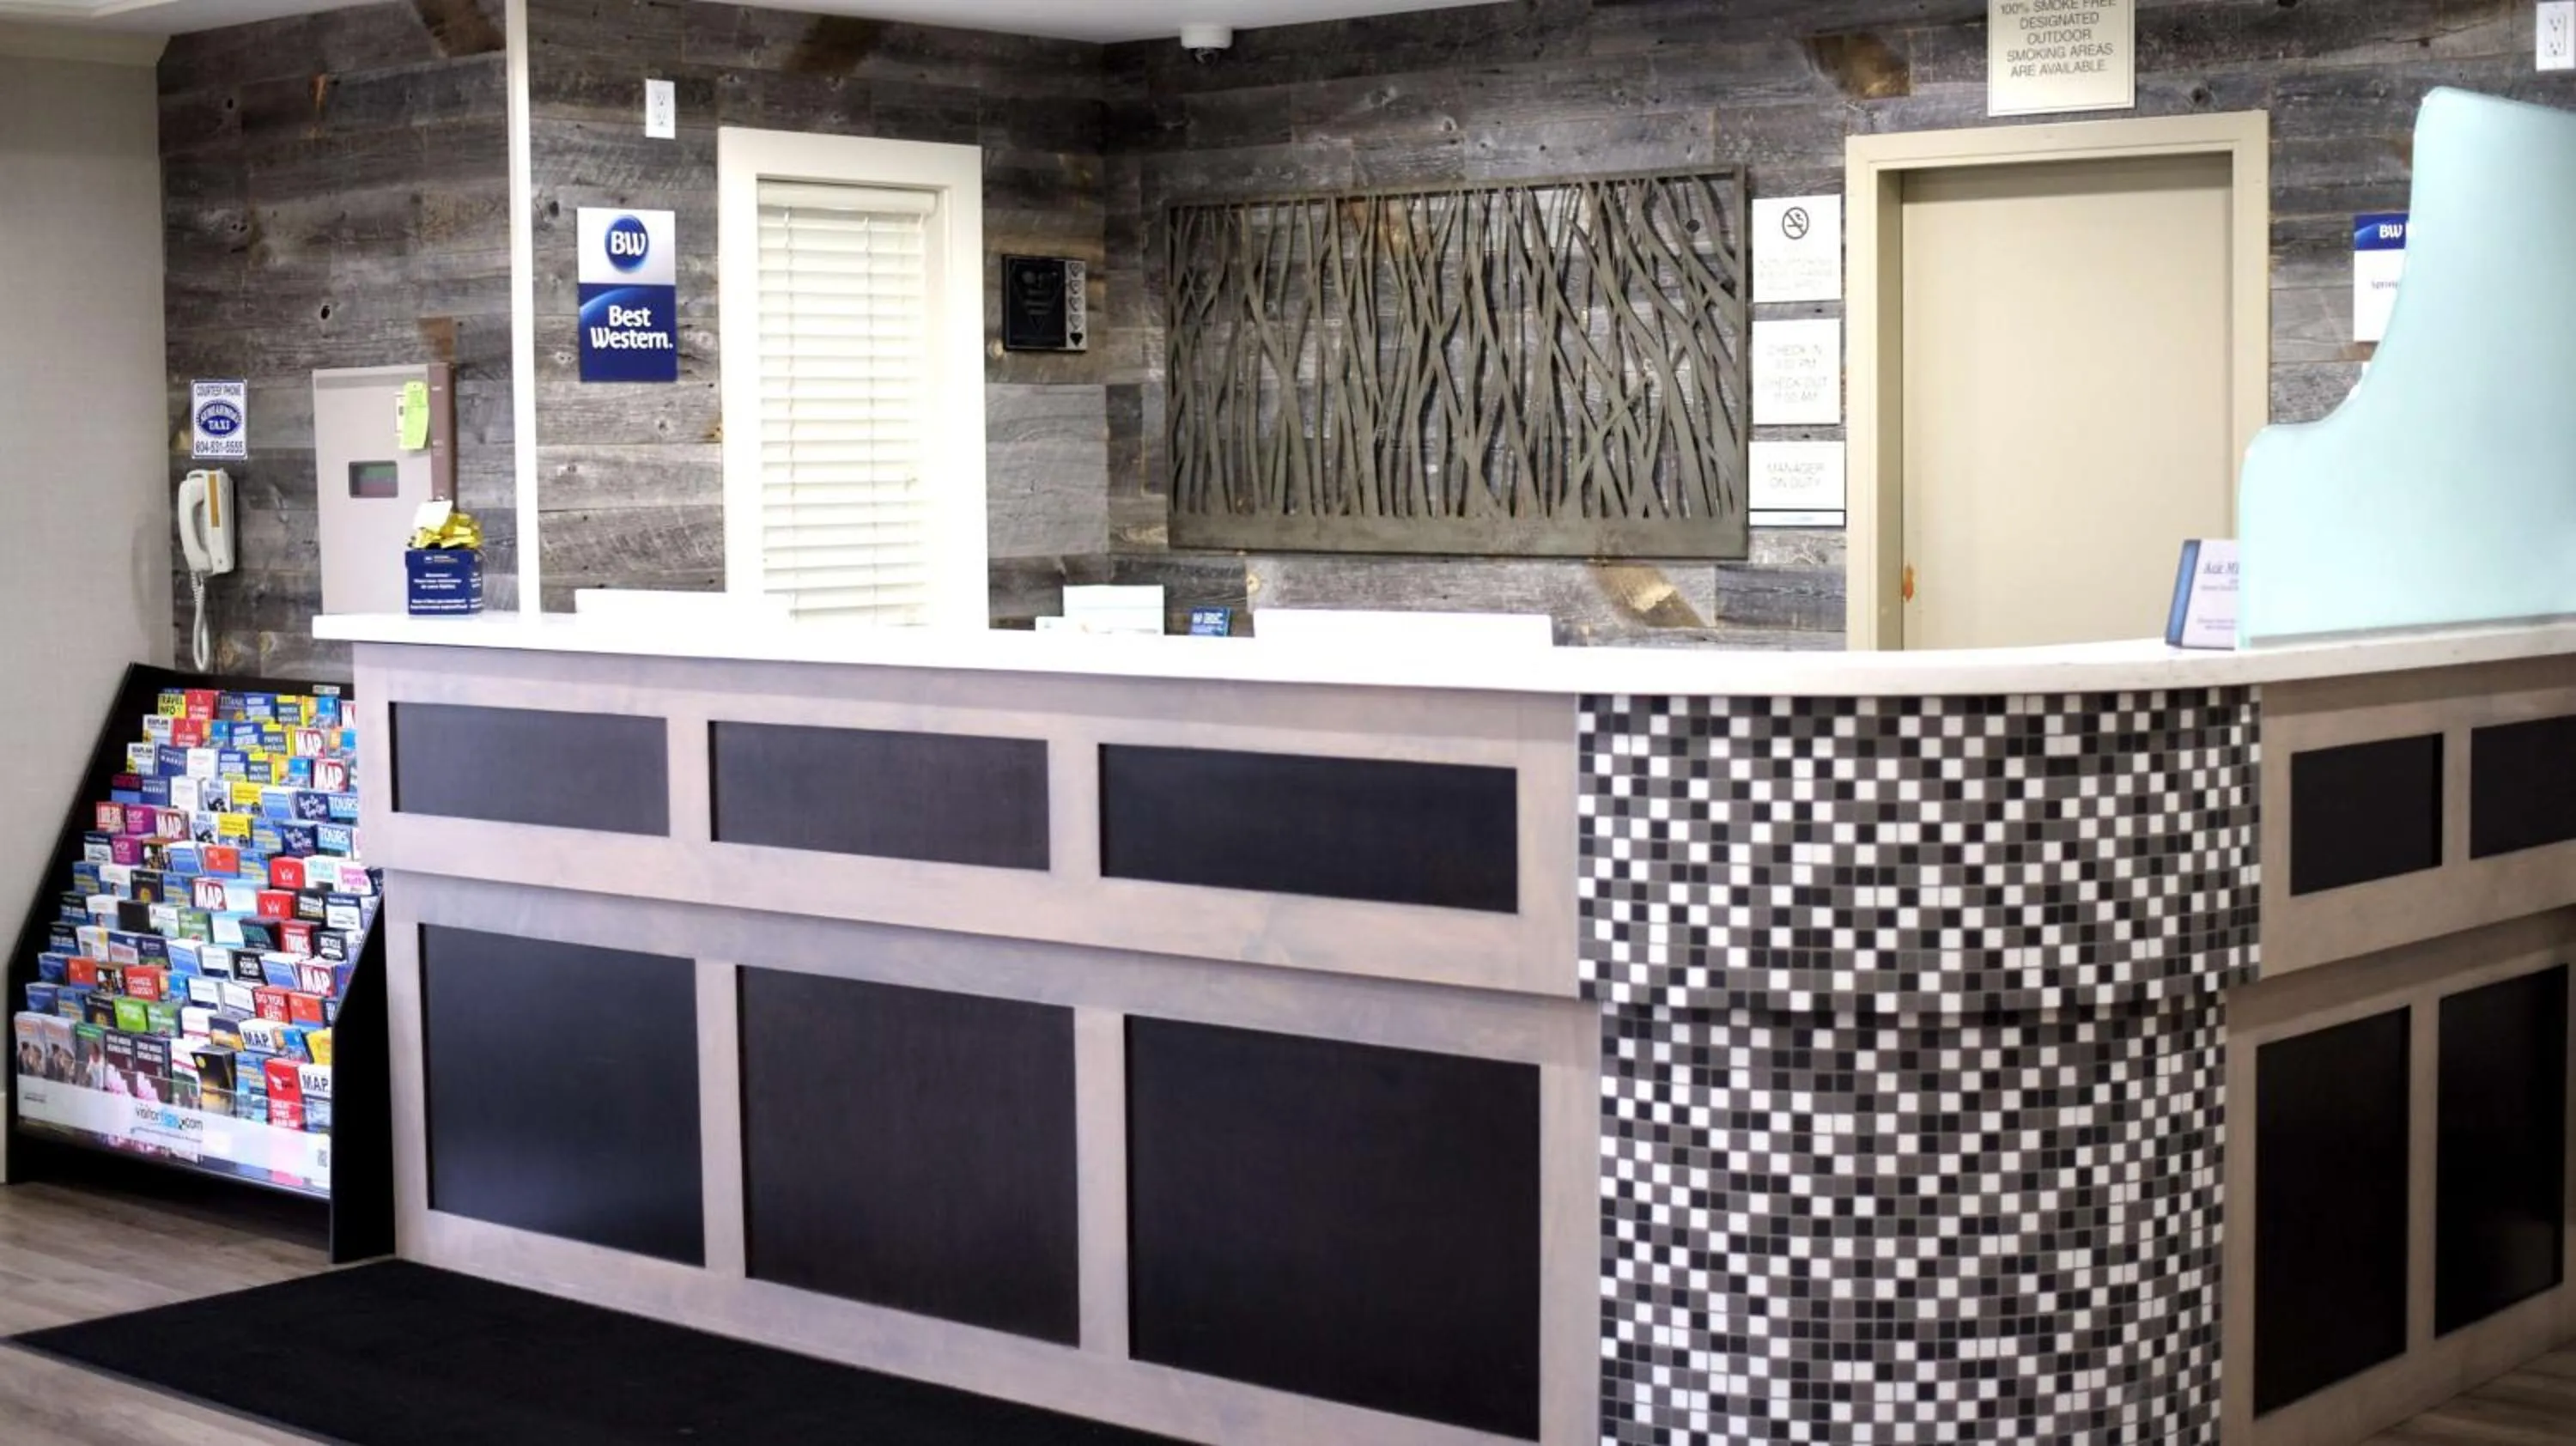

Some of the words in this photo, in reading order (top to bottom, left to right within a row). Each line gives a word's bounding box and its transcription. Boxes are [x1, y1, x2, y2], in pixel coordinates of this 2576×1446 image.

[2033, 0, 2079, 12] SMOKE
[2020, 12, 2099, 29] DESIGNATED
[2026, 29, 2091, 45] OUTDOOR
[2007, 46, 2067, 62] SMOKING
[2069, 43, 2114, 58] AREAS
[2010, 64, 2035, 77] ARE
[2038, 59, 2108, 75] AVAILABLE
[2379, 223, 2403, 239] BW
[611, 230, 647, 256] BW
[608, 305, 652, 327] Best
[1766, 462, 1826, 475] MANAGER
